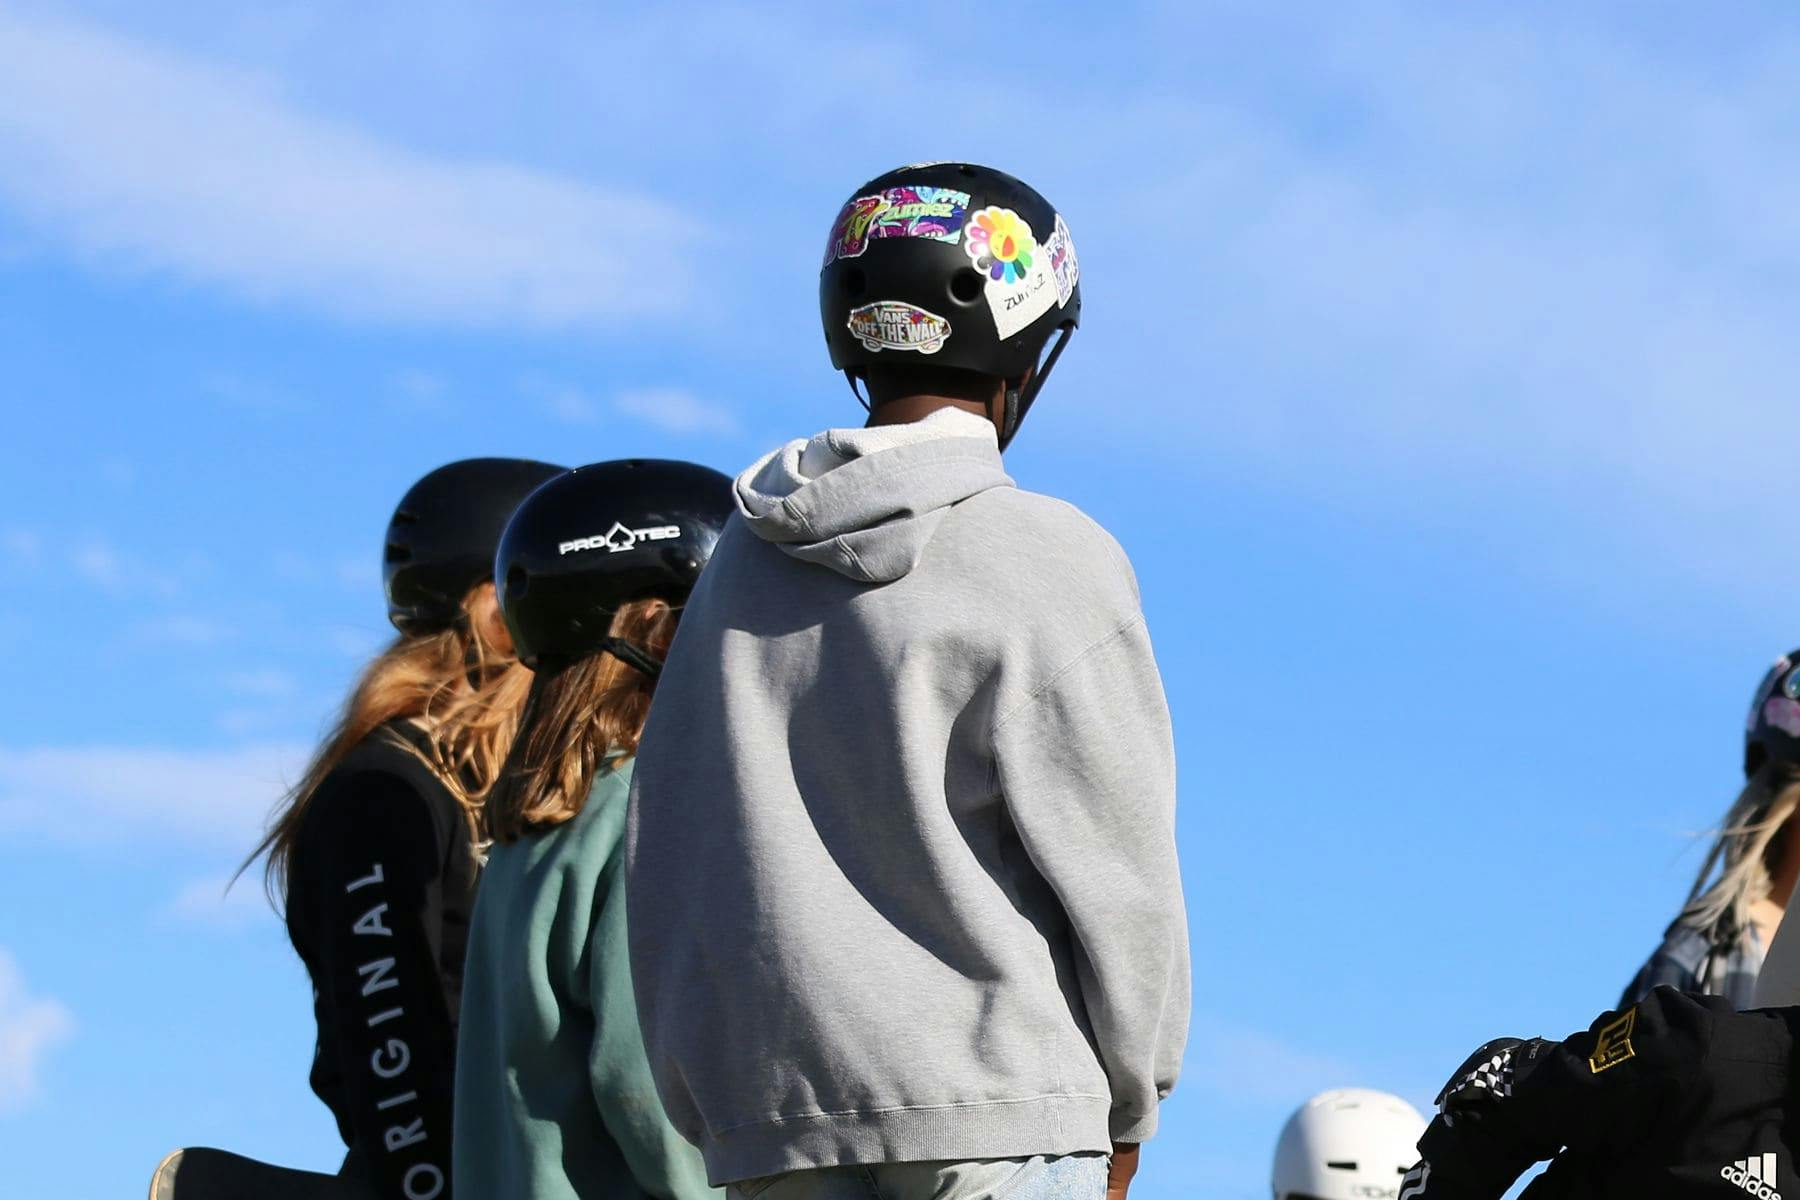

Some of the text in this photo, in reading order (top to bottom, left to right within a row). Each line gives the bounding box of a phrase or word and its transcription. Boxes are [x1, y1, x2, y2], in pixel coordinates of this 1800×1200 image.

[874, 307, 910, 324] VANS
[857, 321, 945, 343] OFF THE WALL
[558, 525, 681, 555] PRO TEC
